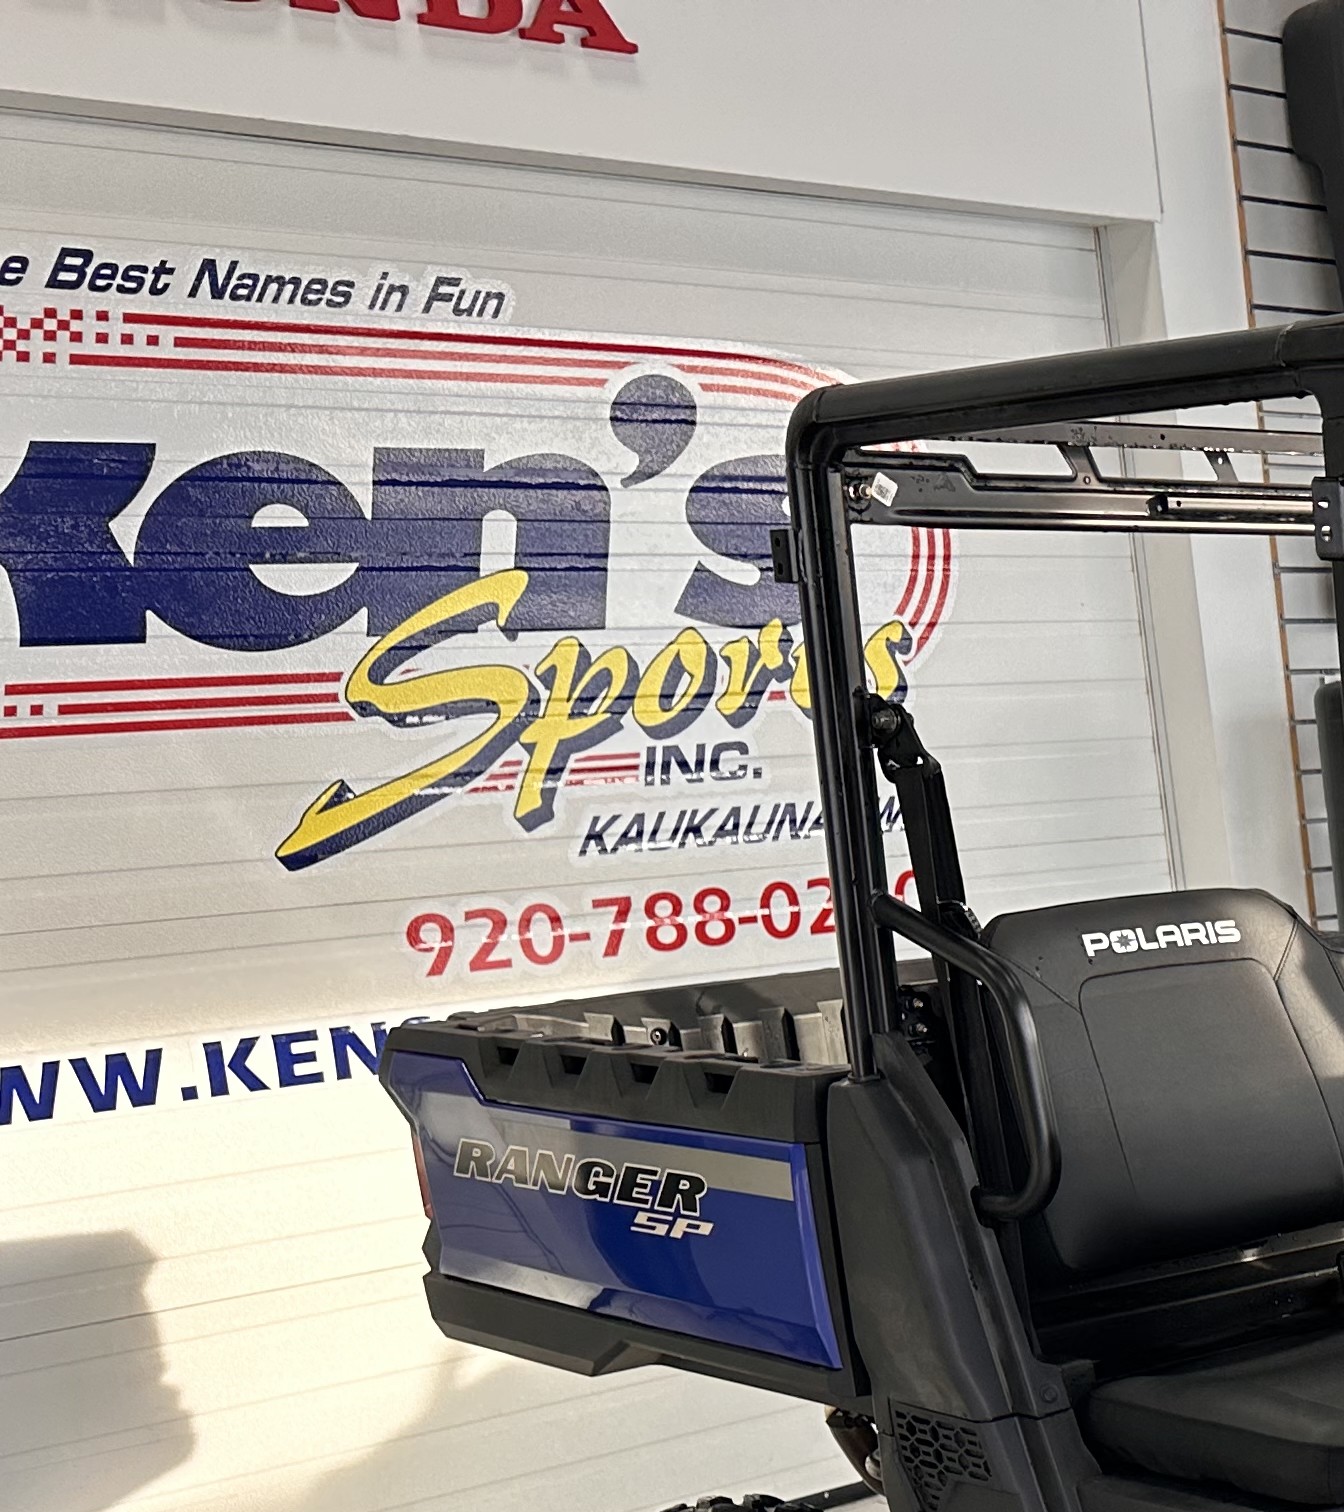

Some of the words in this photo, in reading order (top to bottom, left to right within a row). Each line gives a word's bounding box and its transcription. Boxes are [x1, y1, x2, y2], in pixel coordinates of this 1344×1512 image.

[45, 247, 176, 296] Best
[188, 258, 356, 309] Names
[368, 271, 410, 312] in
[423, 276, 506, 320] Fun
[643, 740, 763, 787] INC.
[406, 869, 917, 977] 920-788-02
[1082, 919, 1242, 957] POLARIS
[454, 1138, 710, 1214] RANGER
[629, 1210, 715, 1240] SP
